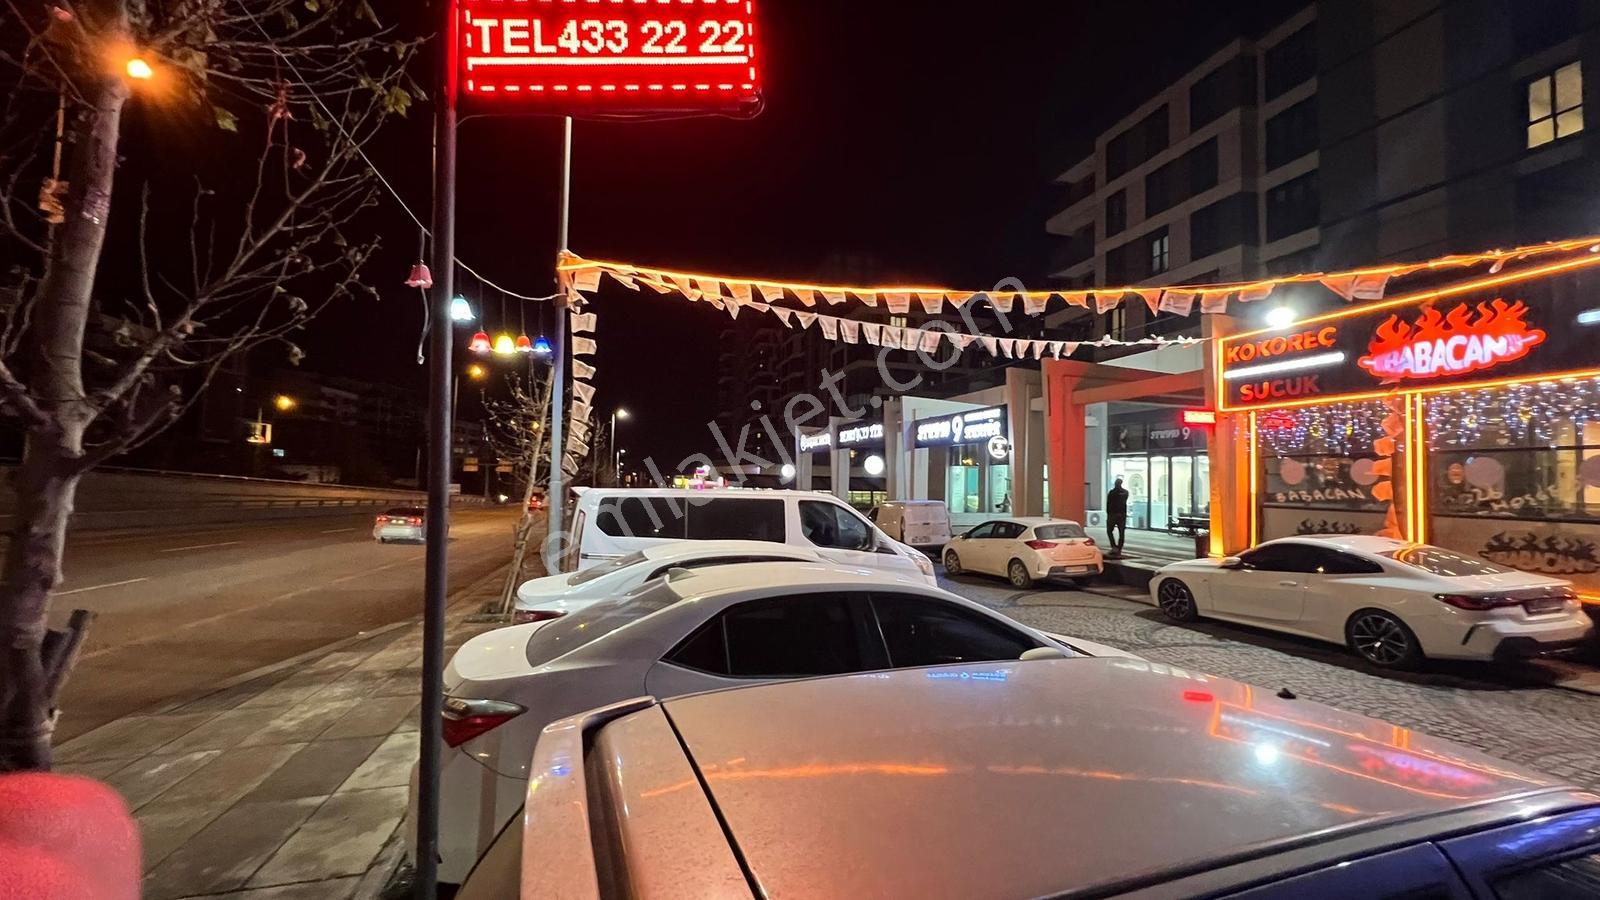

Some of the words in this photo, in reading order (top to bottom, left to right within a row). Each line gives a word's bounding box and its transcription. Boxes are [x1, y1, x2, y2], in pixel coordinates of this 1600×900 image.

[641, 20, 688, 54] 22
[699, 19, 745, 53] 22
[1227, 326, 1337, 363] KOKOREÇ
[1383, 334, 1508, 374] BABACAN
[1239, 374, 1321, 402] SUCUK
[952, 415, 964, 442] 9
[1182, 426, 1190, 440] 9
